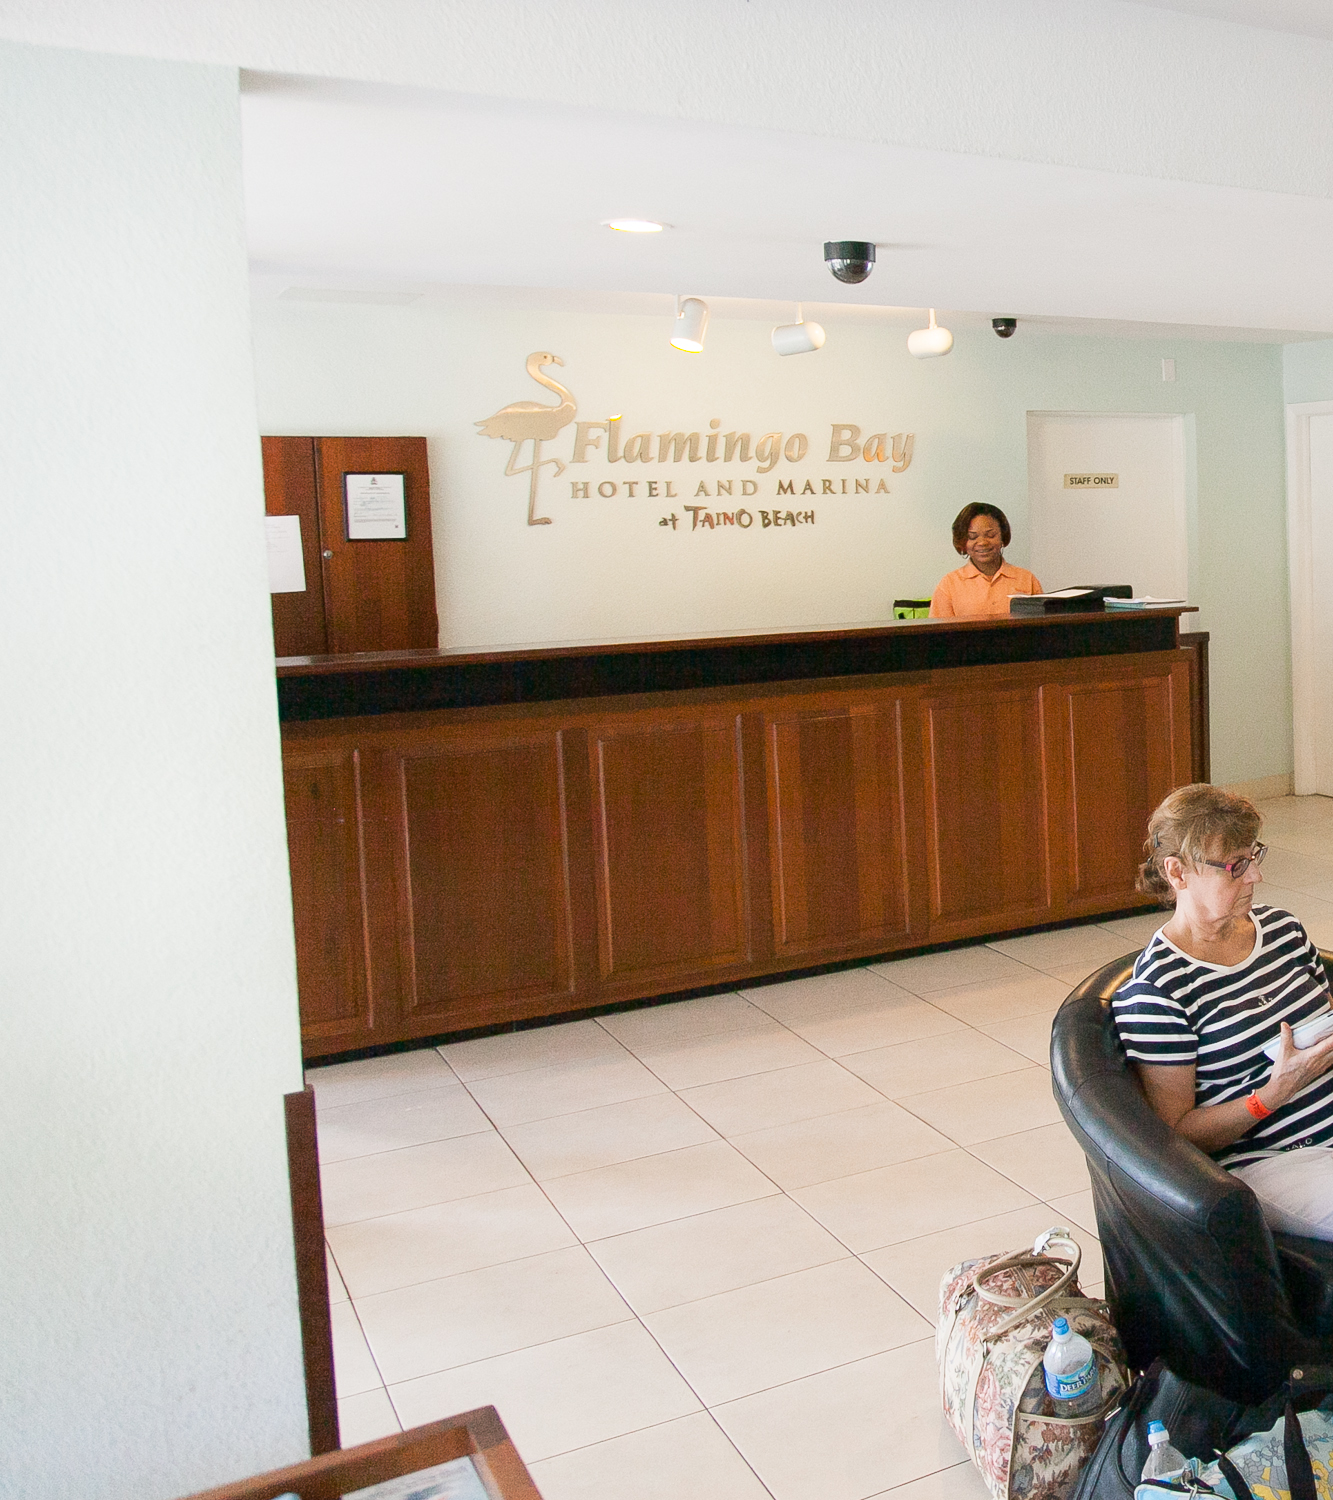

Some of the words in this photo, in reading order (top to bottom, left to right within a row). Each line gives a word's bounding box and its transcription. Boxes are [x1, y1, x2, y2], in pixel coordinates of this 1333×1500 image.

[569, 413, 808, 474] Flamingo
[826, 423, 915, 473] Bay
[570, 480, 678, 499] HOTEL
[694, 479, 759, 497] AND
[776, 477, 891, 496] MARINA
[1069, 477, 1092, 485] STAFF
[1093, 476, 1115, 485] ONLY
[658, 512, 679, 531] at
[683, 504, 754, 532] TAINO
[758, 509, 815, 529] BEACH
[1060, 1380, 1083, 1392] DEER
